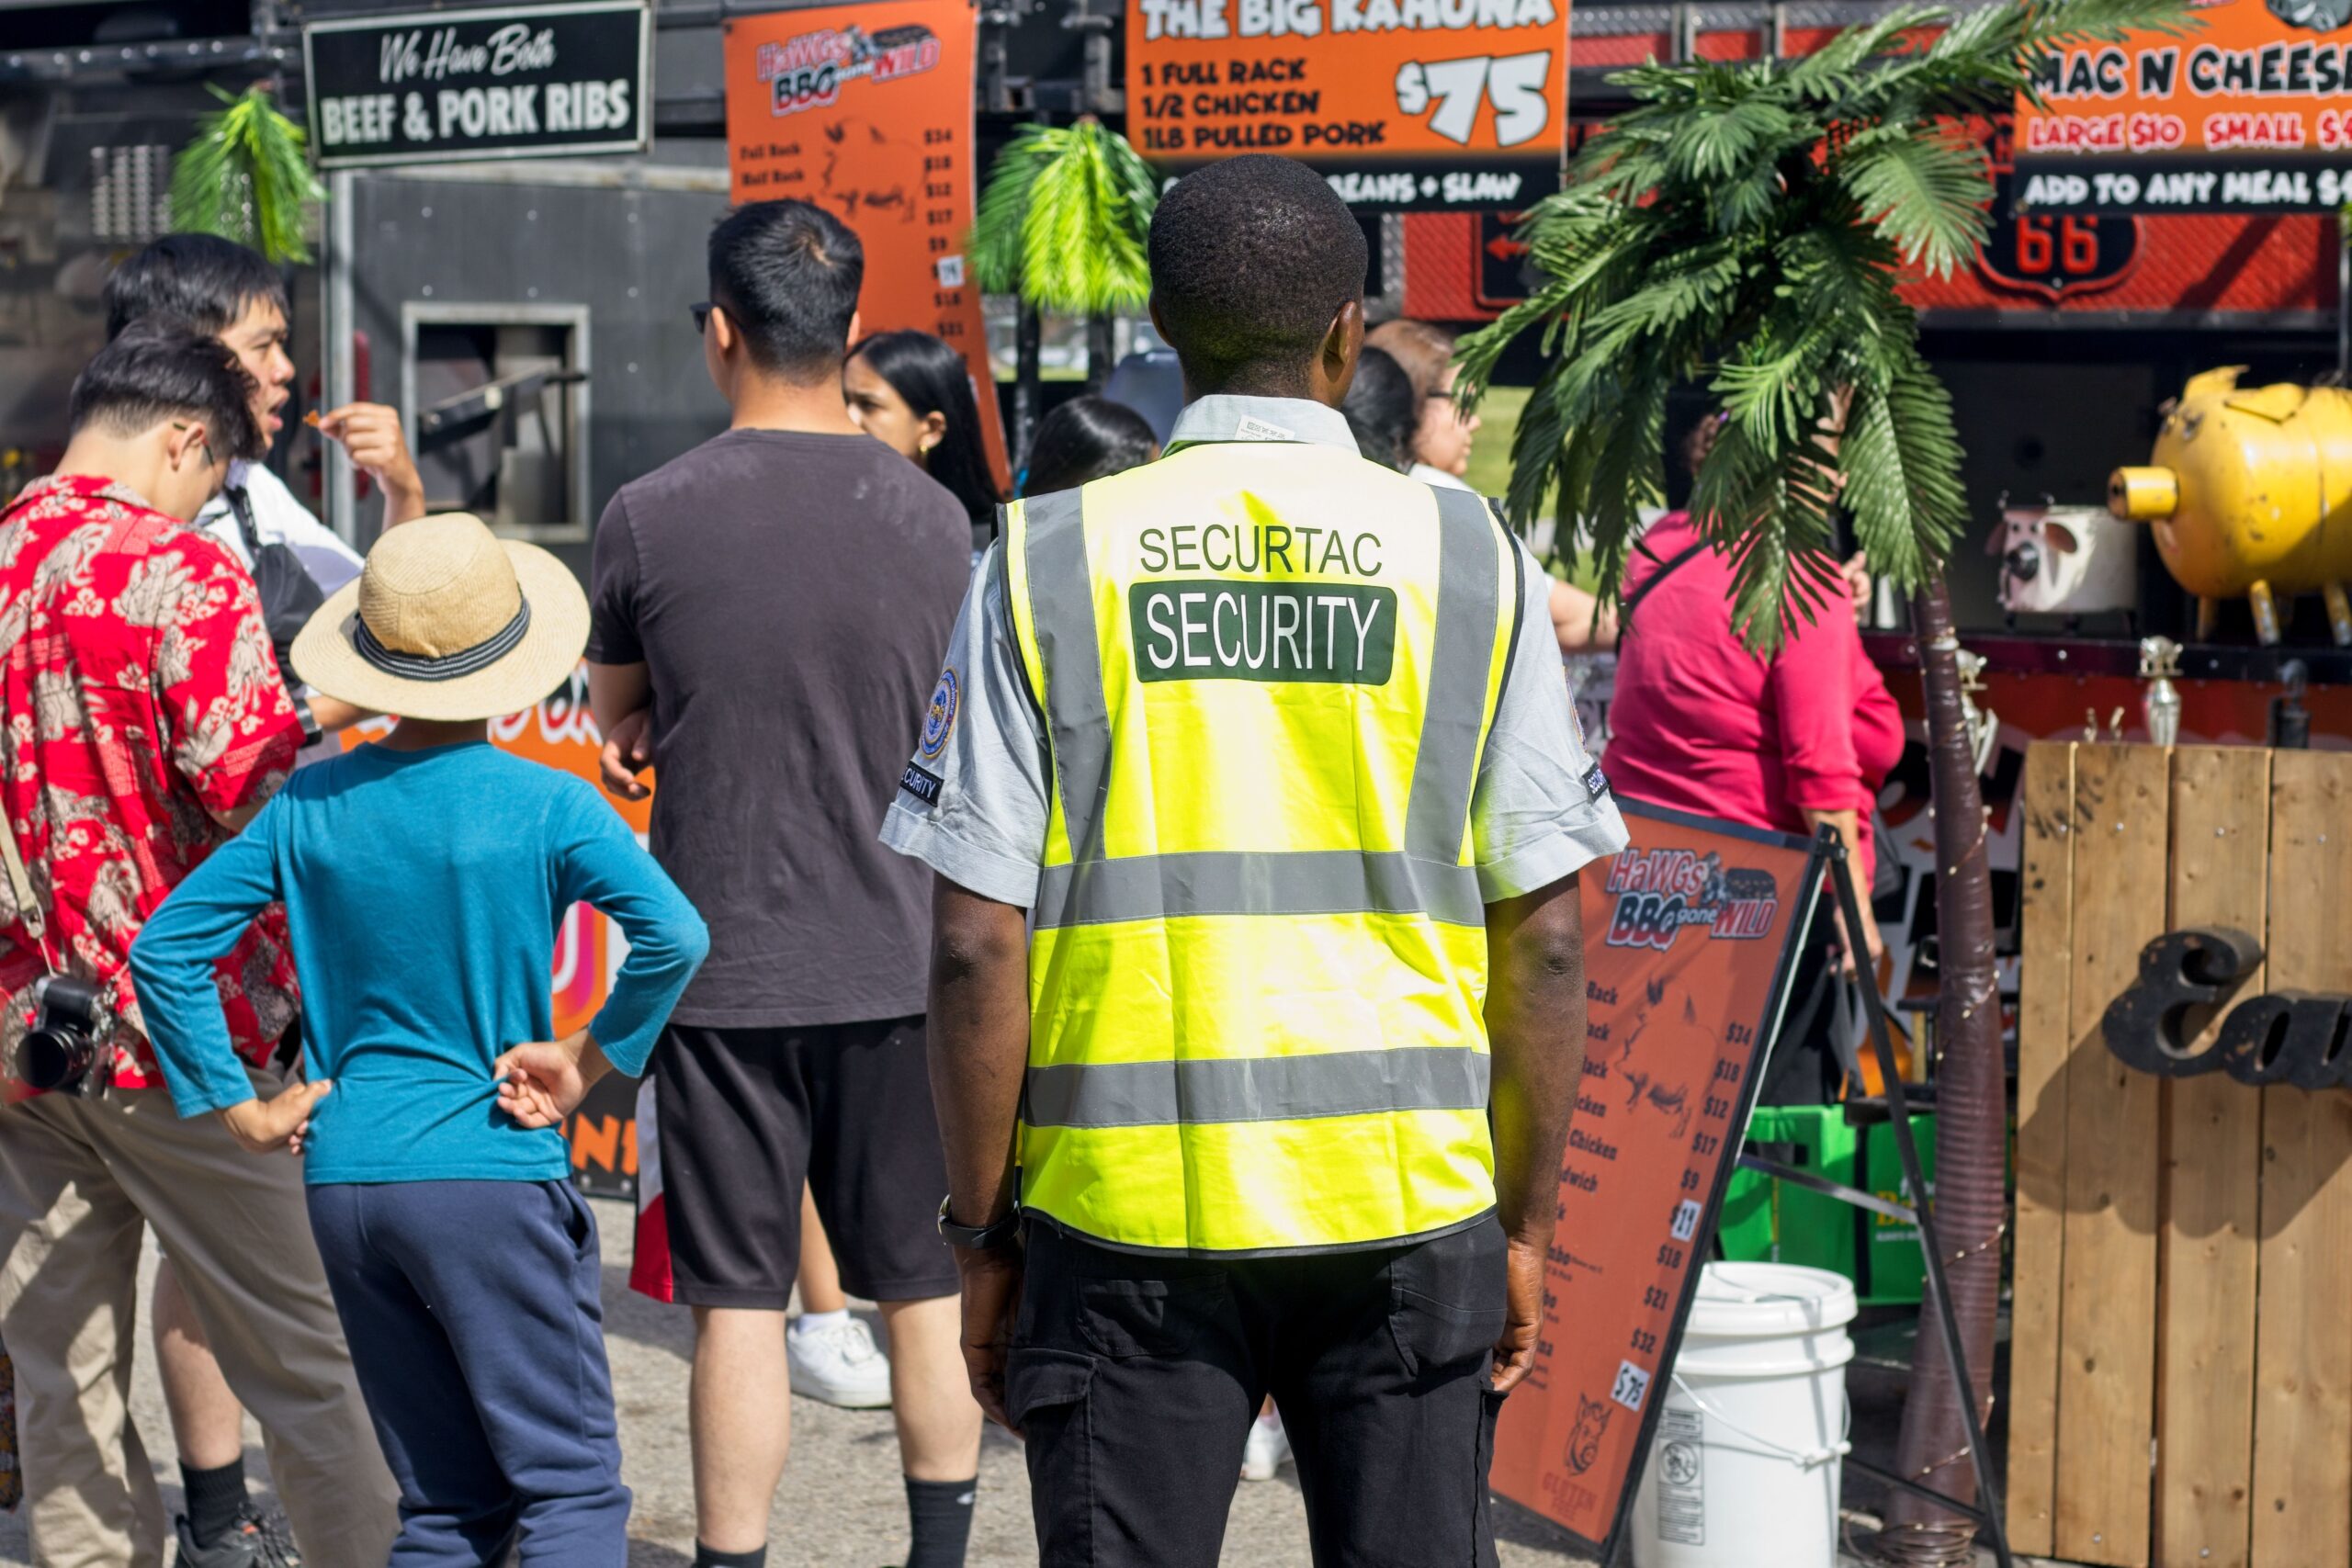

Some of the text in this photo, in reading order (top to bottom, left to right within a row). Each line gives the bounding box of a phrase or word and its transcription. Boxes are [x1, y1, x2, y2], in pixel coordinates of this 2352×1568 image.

[1140, 0, 1558, 40] THE BIG KAHUNA
[379, 23, 556, 83] We Have Both
[1141, 58, 1306, 86] 1 FULL RACK
[2027, 49, 2129, 98] MAC
[2137, 46, 2179, 100] N
[322, 78, 630, 145] BEEF & PORK RIBS
[1142, 91, 1320, 118] 1/2 CHICKEN
[1396, 50, 1552, 147] $75
[1143, 121, 1385, 149] 1LB PULLED PORK
[2029, 114, 2125, 153] LARGE
[2130, 113, 2185, 153] $10
[2204, 112, 2305, 152] SMALL
[1442, 172, 1521, 203] SLAW
[2025, 175, 2089, 205] ADD
[2093, 174, 2140, 205] TO
[2144, 173, 2217, 204] ANY
[2222, 170, 2312, 204] MEAL
[2017, 215, 2098, 273] 66
[1140, 525, 1382, 577] SECURTAC
[1147, 592, 1380, 671] SECURITY
[901, 768, 935, 798] CURITY
[1606, 847, 1708, 897] HaWGs
[1606, 891, 1687, 953] BBQ
[1710, 898, 1778, 939] WILD
[1587, 980, 1618, 1006] Rack
[1703, 1096, 1728, 1119] $12
[1569, 1129, 1618, 1161] Chicken
[1692, 1132, 1718, 1156] $17
[1560, 1166, 1598, 1192] dwich
[1680, 1168, 1699, 1190] $9
[1644, 1284, 1668, 1311] $21
[1631, 1327, 1657, 1354] $32
